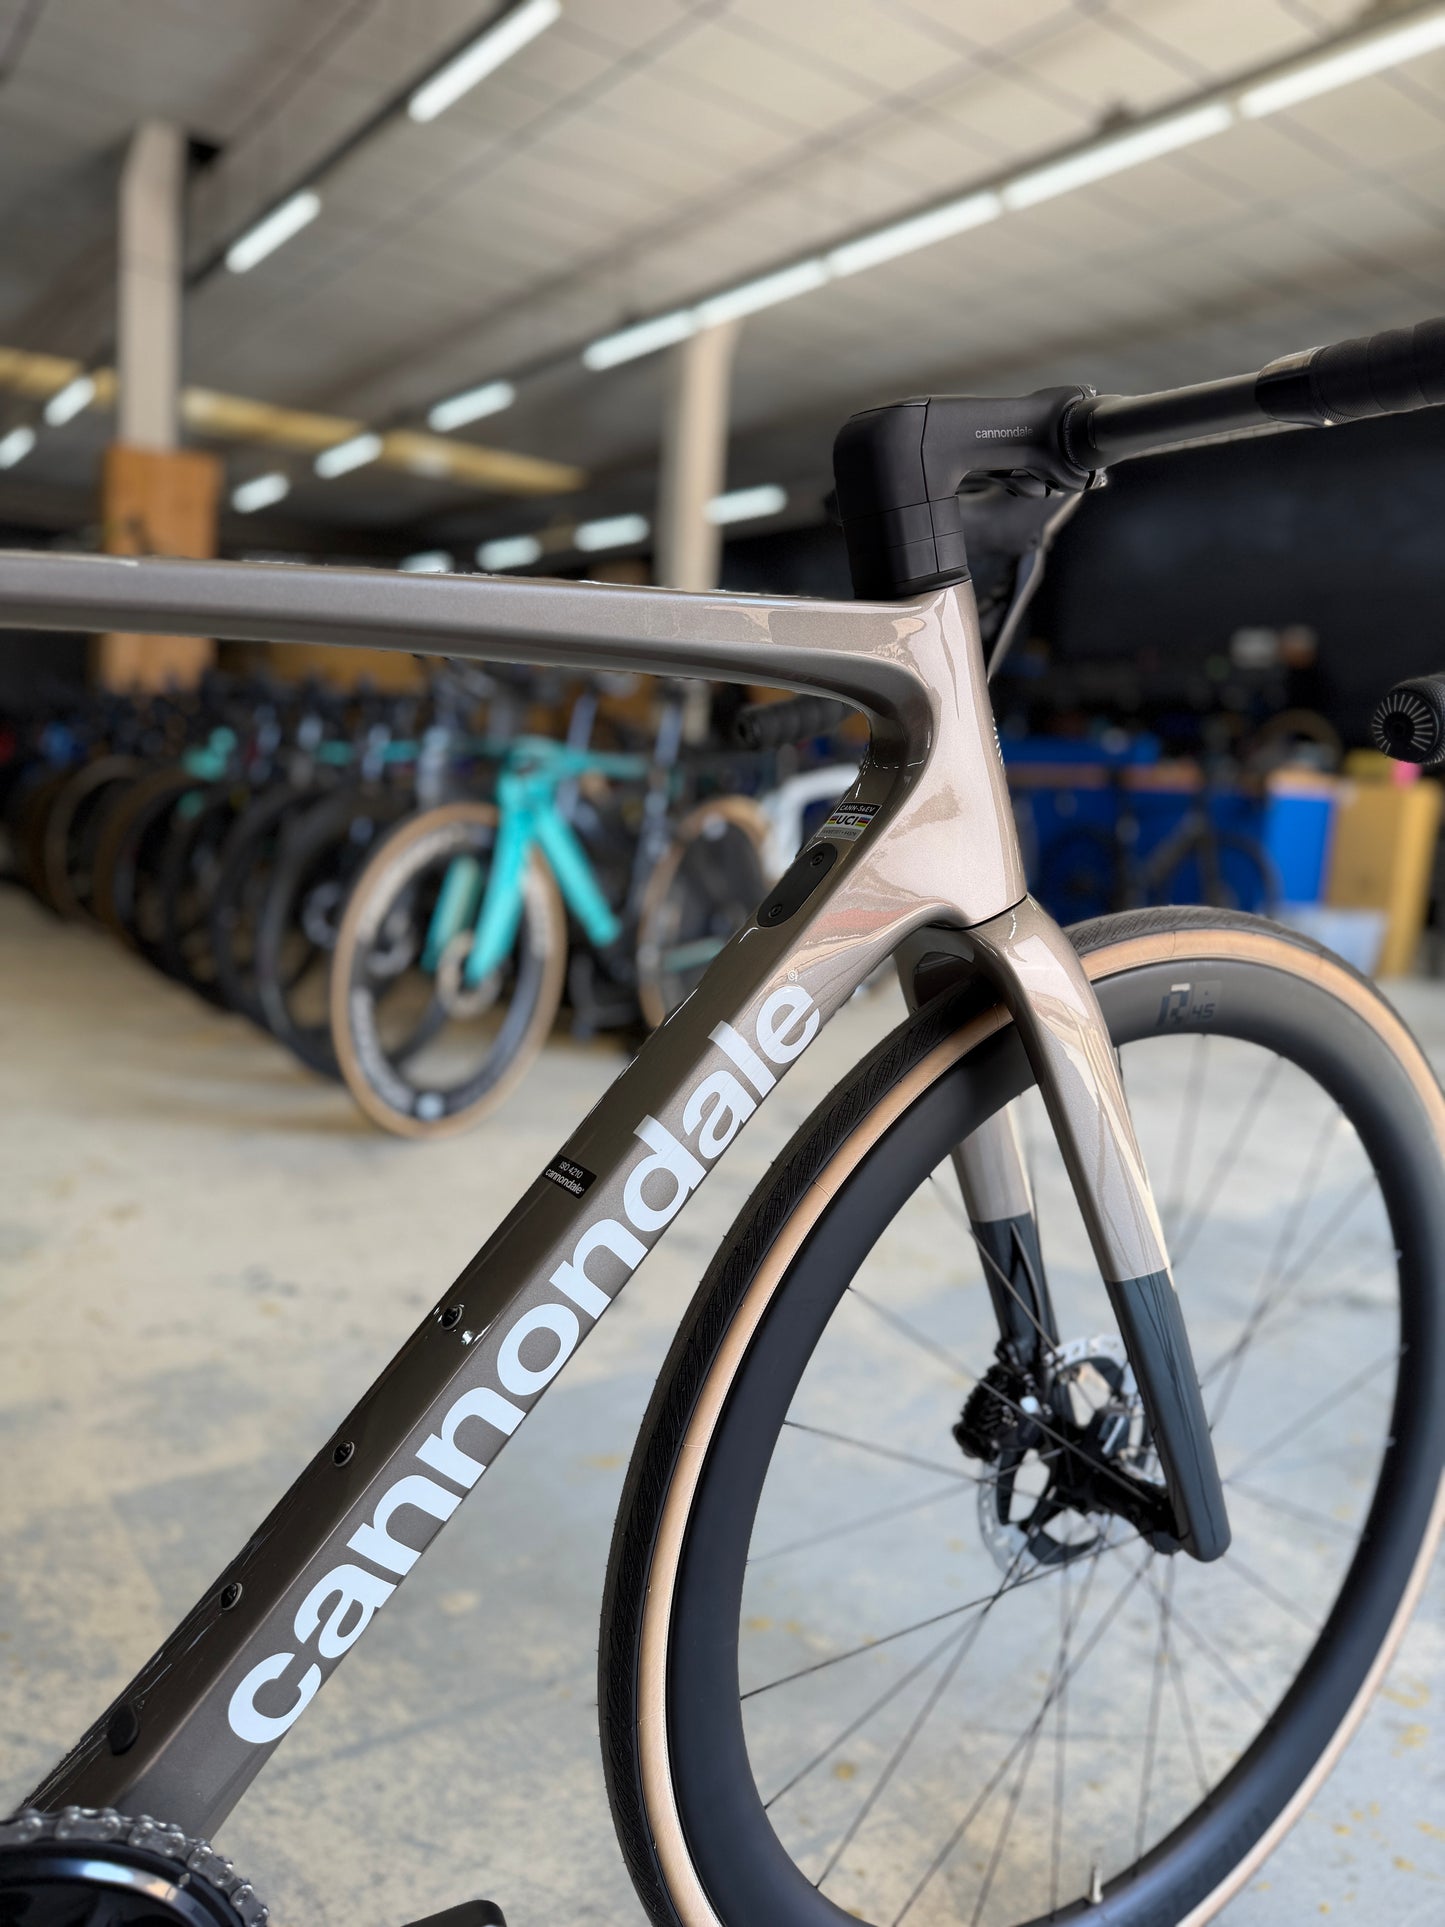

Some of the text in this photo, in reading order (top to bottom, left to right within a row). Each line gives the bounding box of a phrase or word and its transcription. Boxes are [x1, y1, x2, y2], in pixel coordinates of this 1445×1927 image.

[975, 426, 1034, 439] cannondale
[836, 815, 860, 826] UCI
[559, 1161, 584, 1179] ISO 4210
[545, 1168, 583, 1194] cannondale
[227, 983, 820, 1744] cannondale
